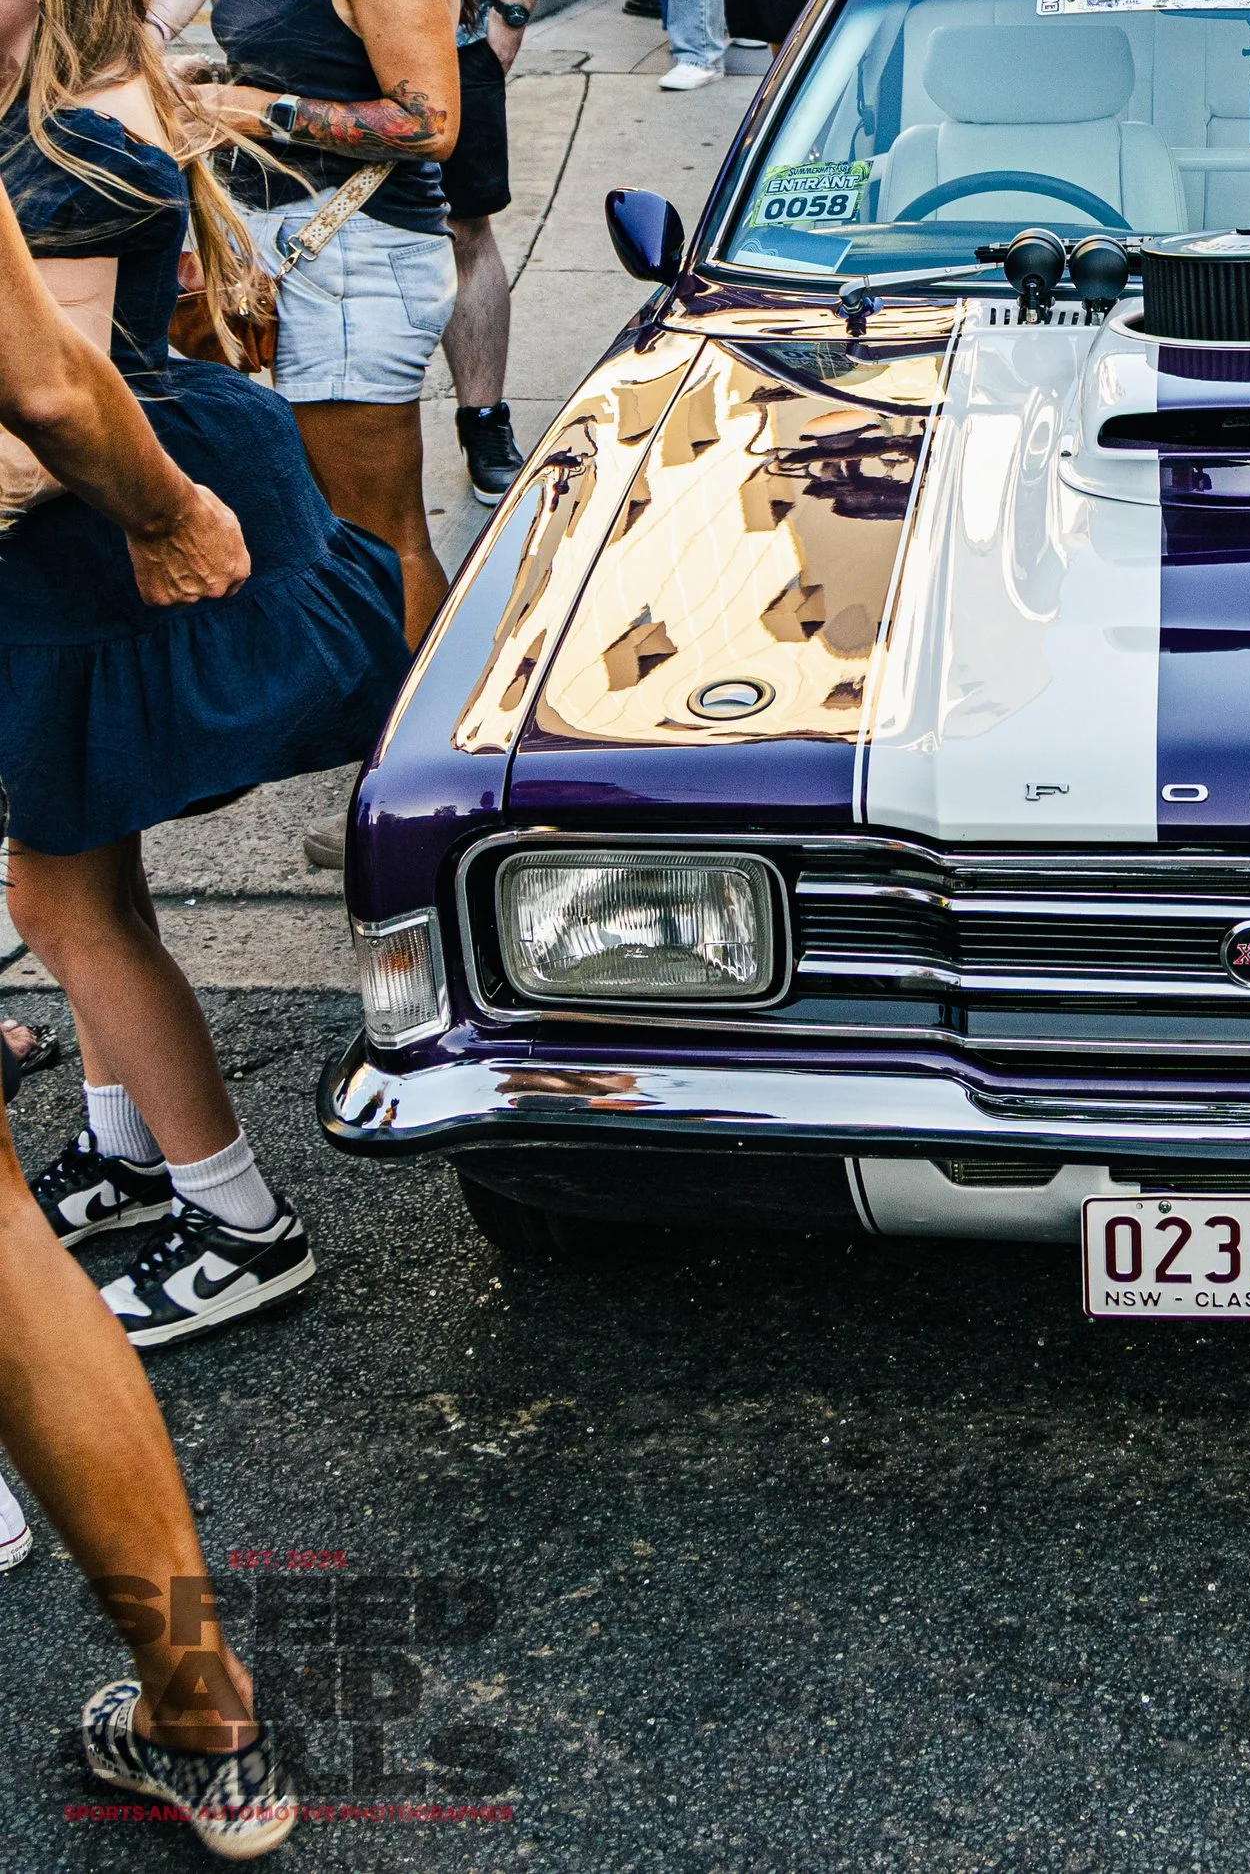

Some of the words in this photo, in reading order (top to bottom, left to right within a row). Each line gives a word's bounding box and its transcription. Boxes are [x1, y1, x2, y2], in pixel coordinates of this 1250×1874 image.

[766, 175, 860, 195] ENTRANT
[764, 194, 850, 220] 0058
[1105, 1292, 1162, 1307] NSW
